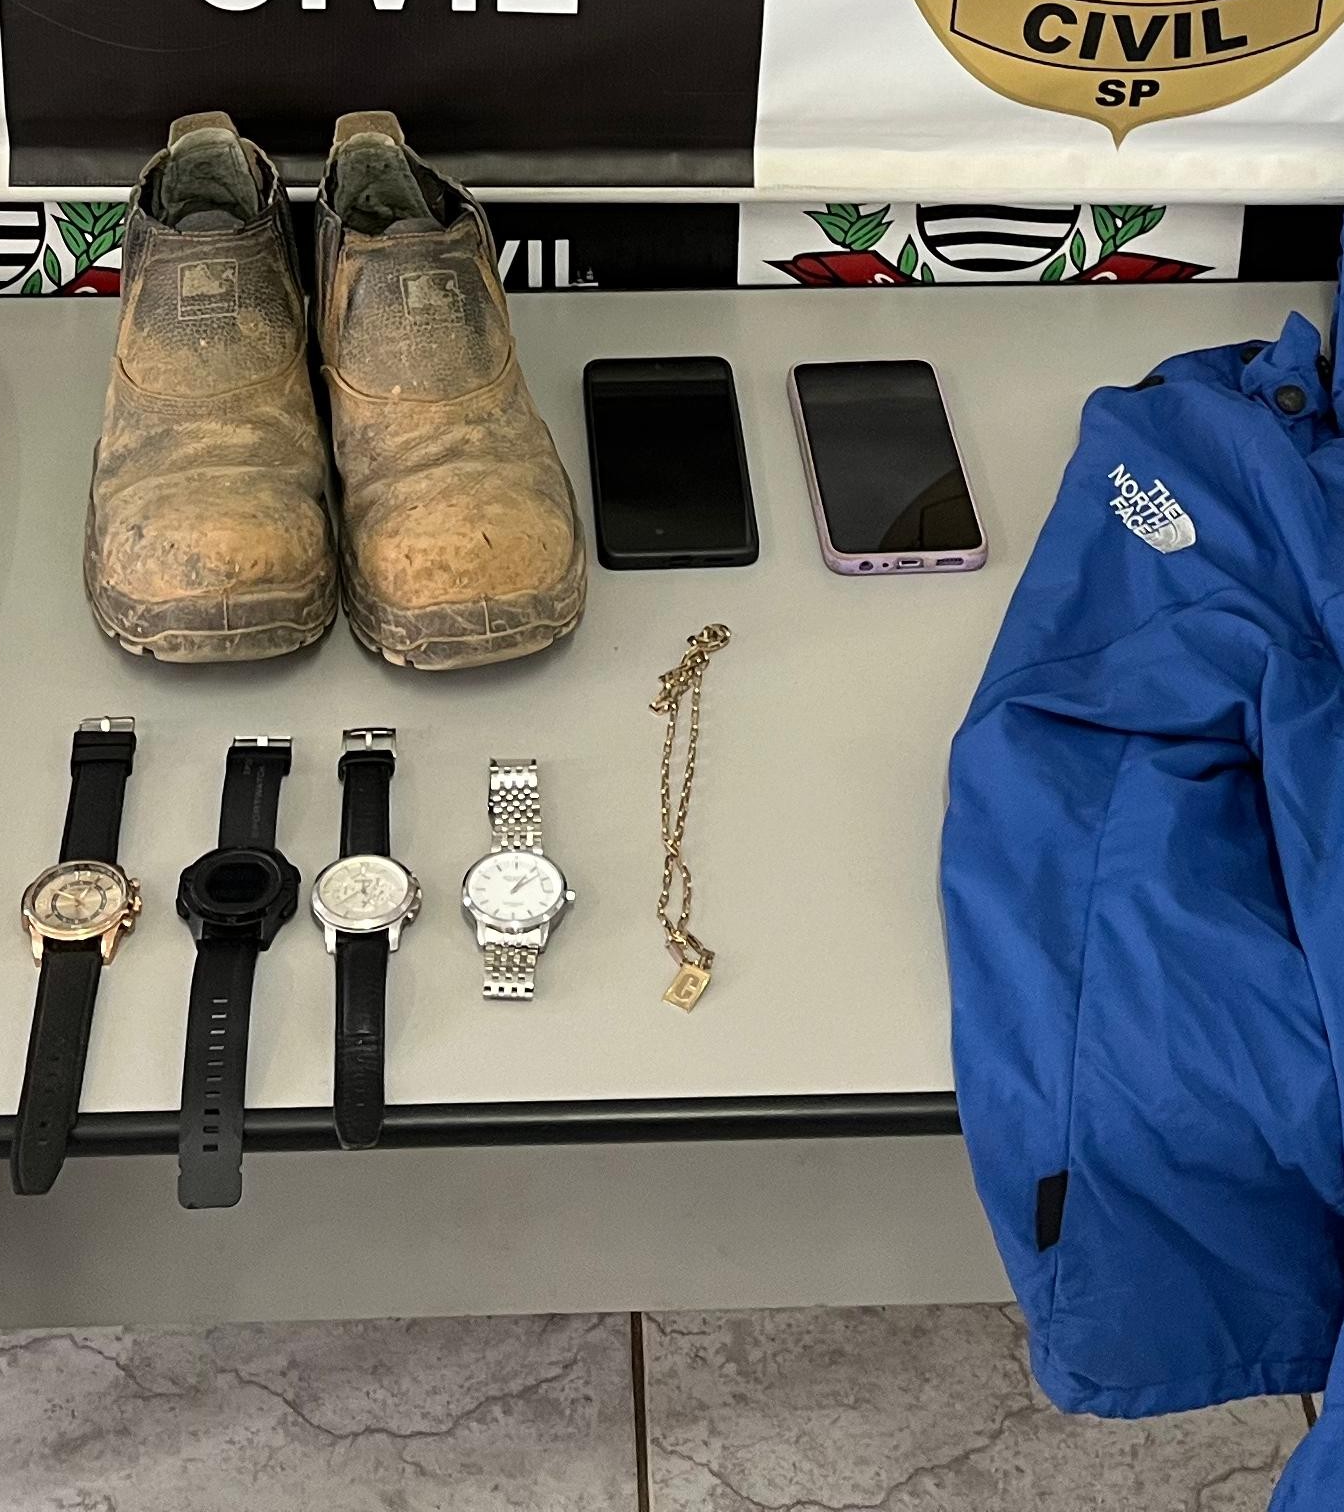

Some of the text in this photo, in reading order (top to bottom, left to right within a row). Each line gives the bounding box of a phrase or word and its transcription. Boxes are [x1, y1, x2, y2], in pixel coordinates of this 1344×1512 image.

[1024, 3, 1247, 61] CIVIL
[1096, 79, 1160, 107] SP
[1108, 463, 1170, 530] NORTH
[1109, 495, 1154, 535] FACE
[1148, 479, 1184, 520] THE
